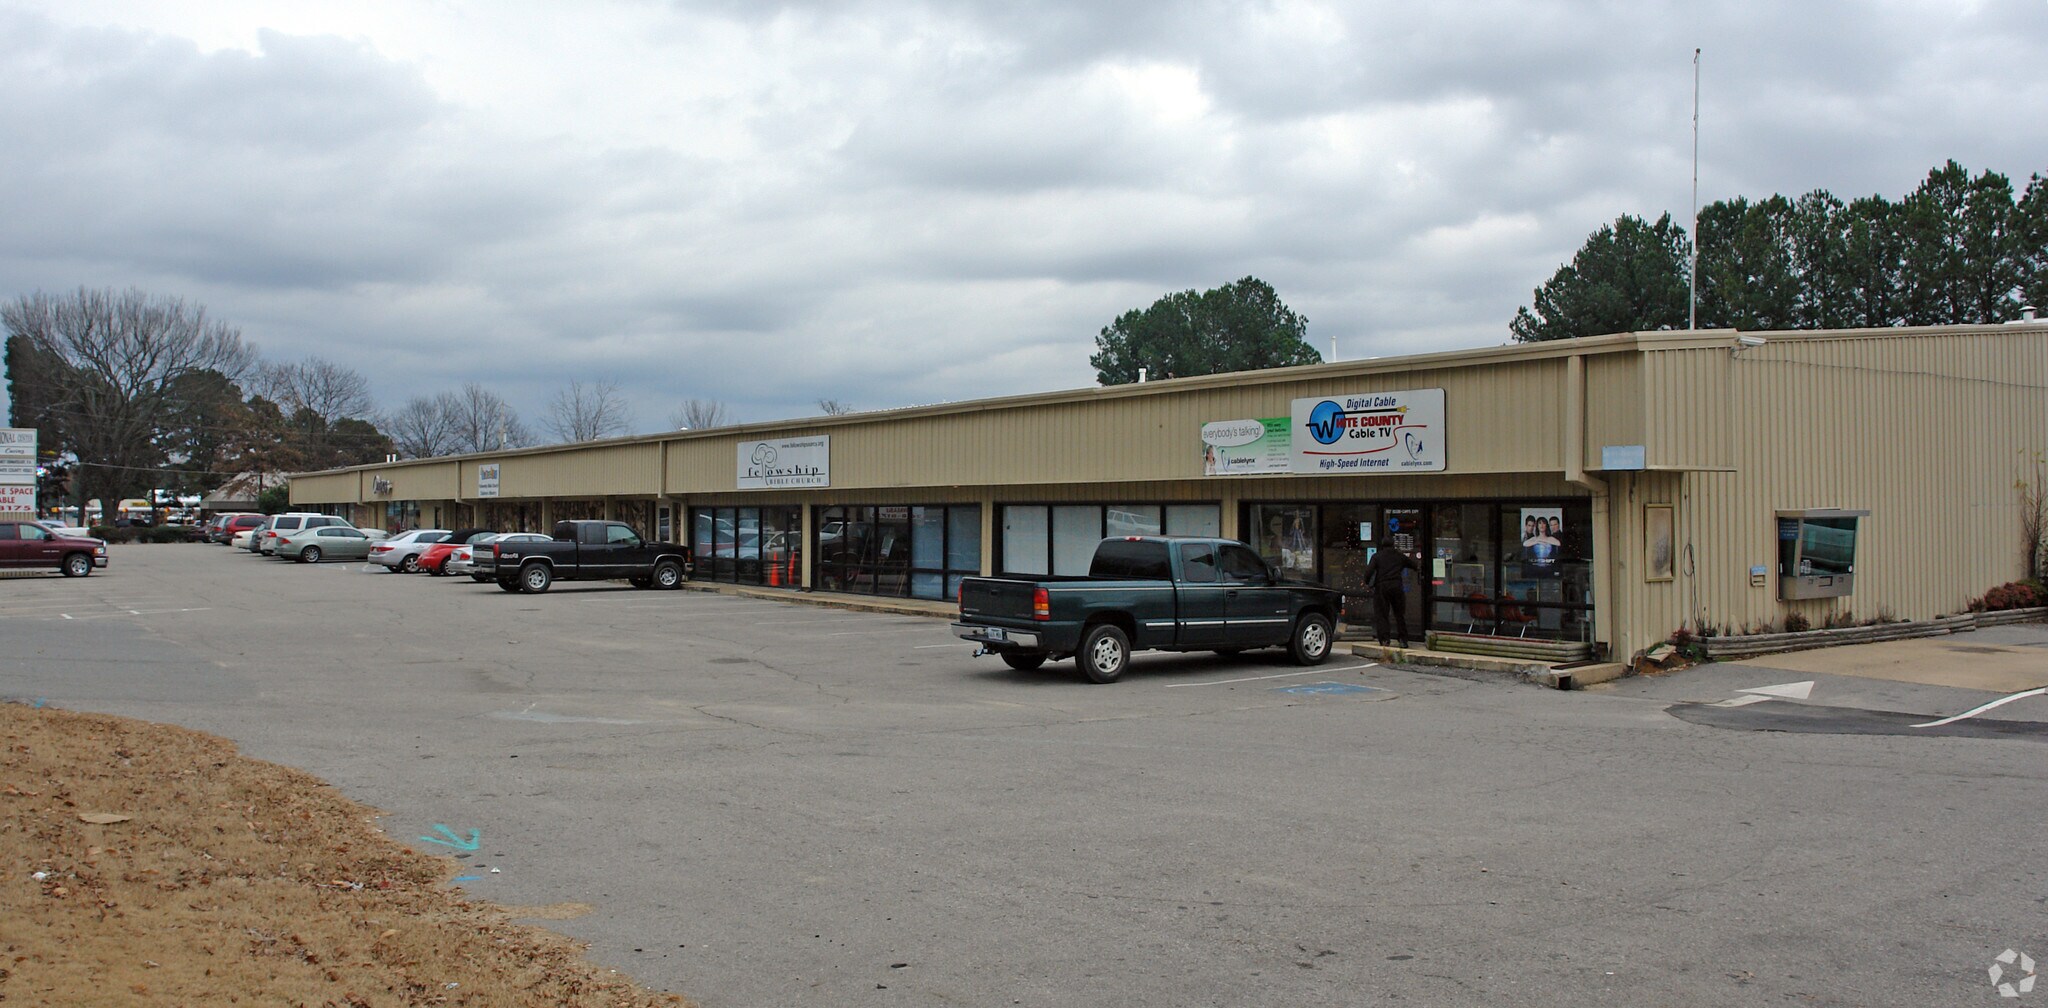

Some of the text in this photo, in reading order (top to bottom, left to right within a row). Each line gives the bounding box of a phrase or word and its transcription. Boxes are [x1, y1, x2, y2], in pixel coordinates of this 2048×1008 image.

[1346, 396, 1397, 410] Digital Cable
[1360, 415, 1404, 427] COUNTY
[1203, 425, 1261, 440] everybody's talking!
[1349, 427, 1392, 439] Cable TV
[1231, 457, 1256, 465] cablelynx
[1319, 458, 1390, 470] High-Speed Internet
[1401, 460, 1433, 468] cablelynx.com
[10, 487, 34, 495] SPACE
